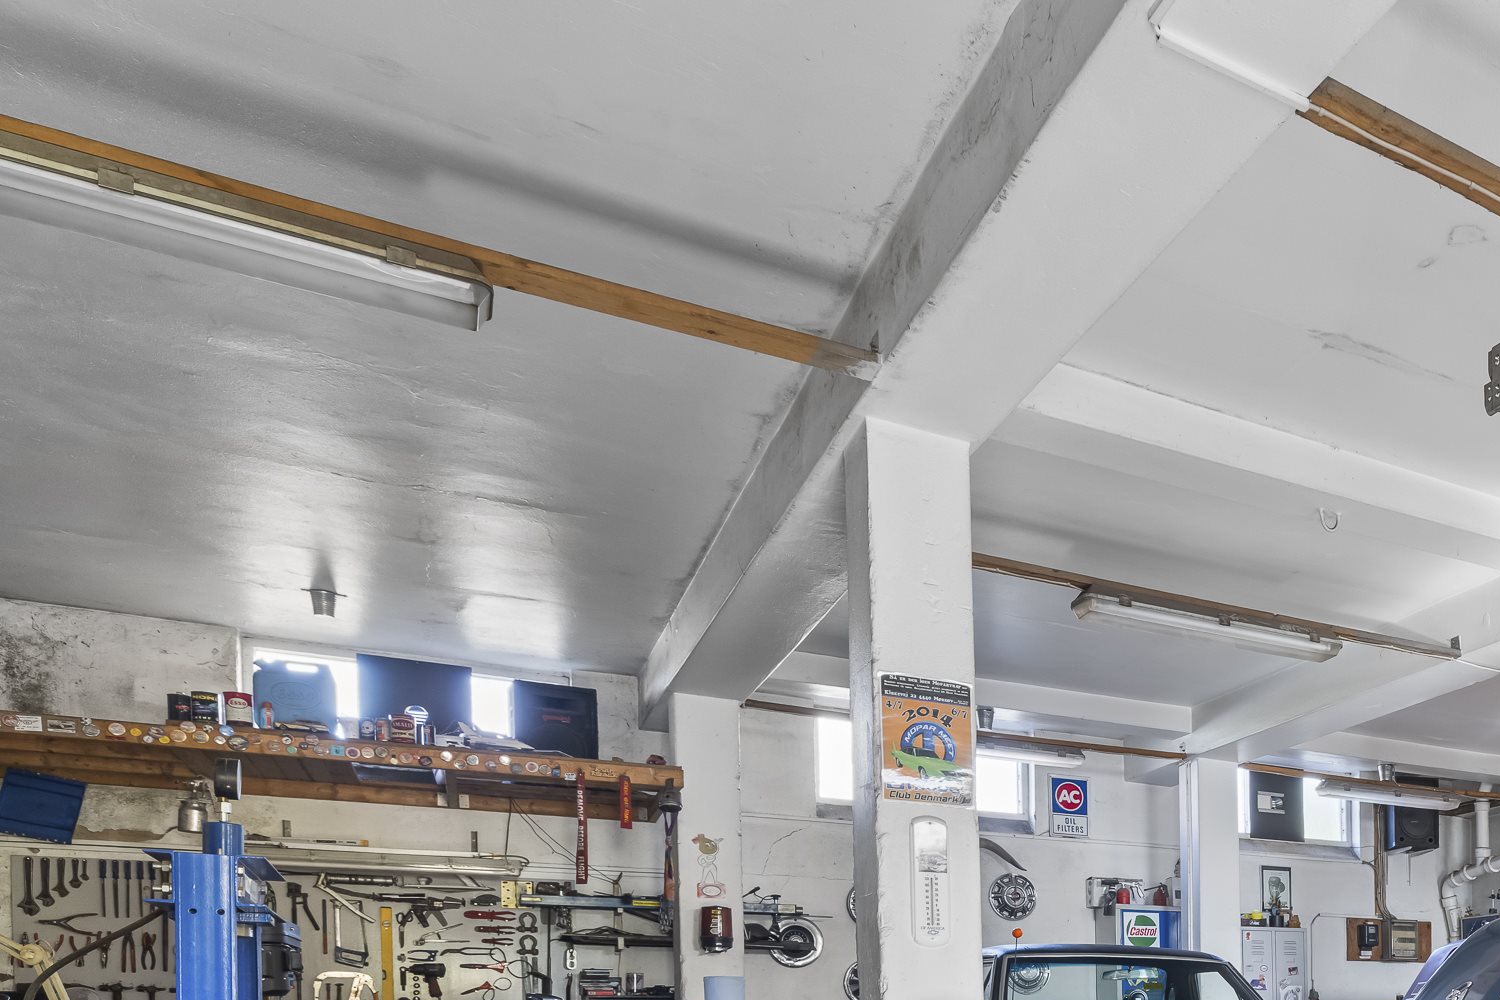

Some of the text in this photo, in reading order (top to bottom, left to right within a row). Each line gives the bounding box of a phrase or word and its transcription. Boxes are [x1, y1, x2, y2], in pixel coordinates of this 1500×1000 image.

[902, 706, 953, 728] 2014
[951, 707, 967, 719] 6/7
[904, 724, 955, 758] MOPAR MEET
[889, 790, 961, 804] Club Denmark
[1058, 789, 1081, 804] AC
[1064, 817, 1077, 825] OIL
[1057, 824, 1084, 833] FILTERS
[1129, 926, 1158, 937] Castrol
